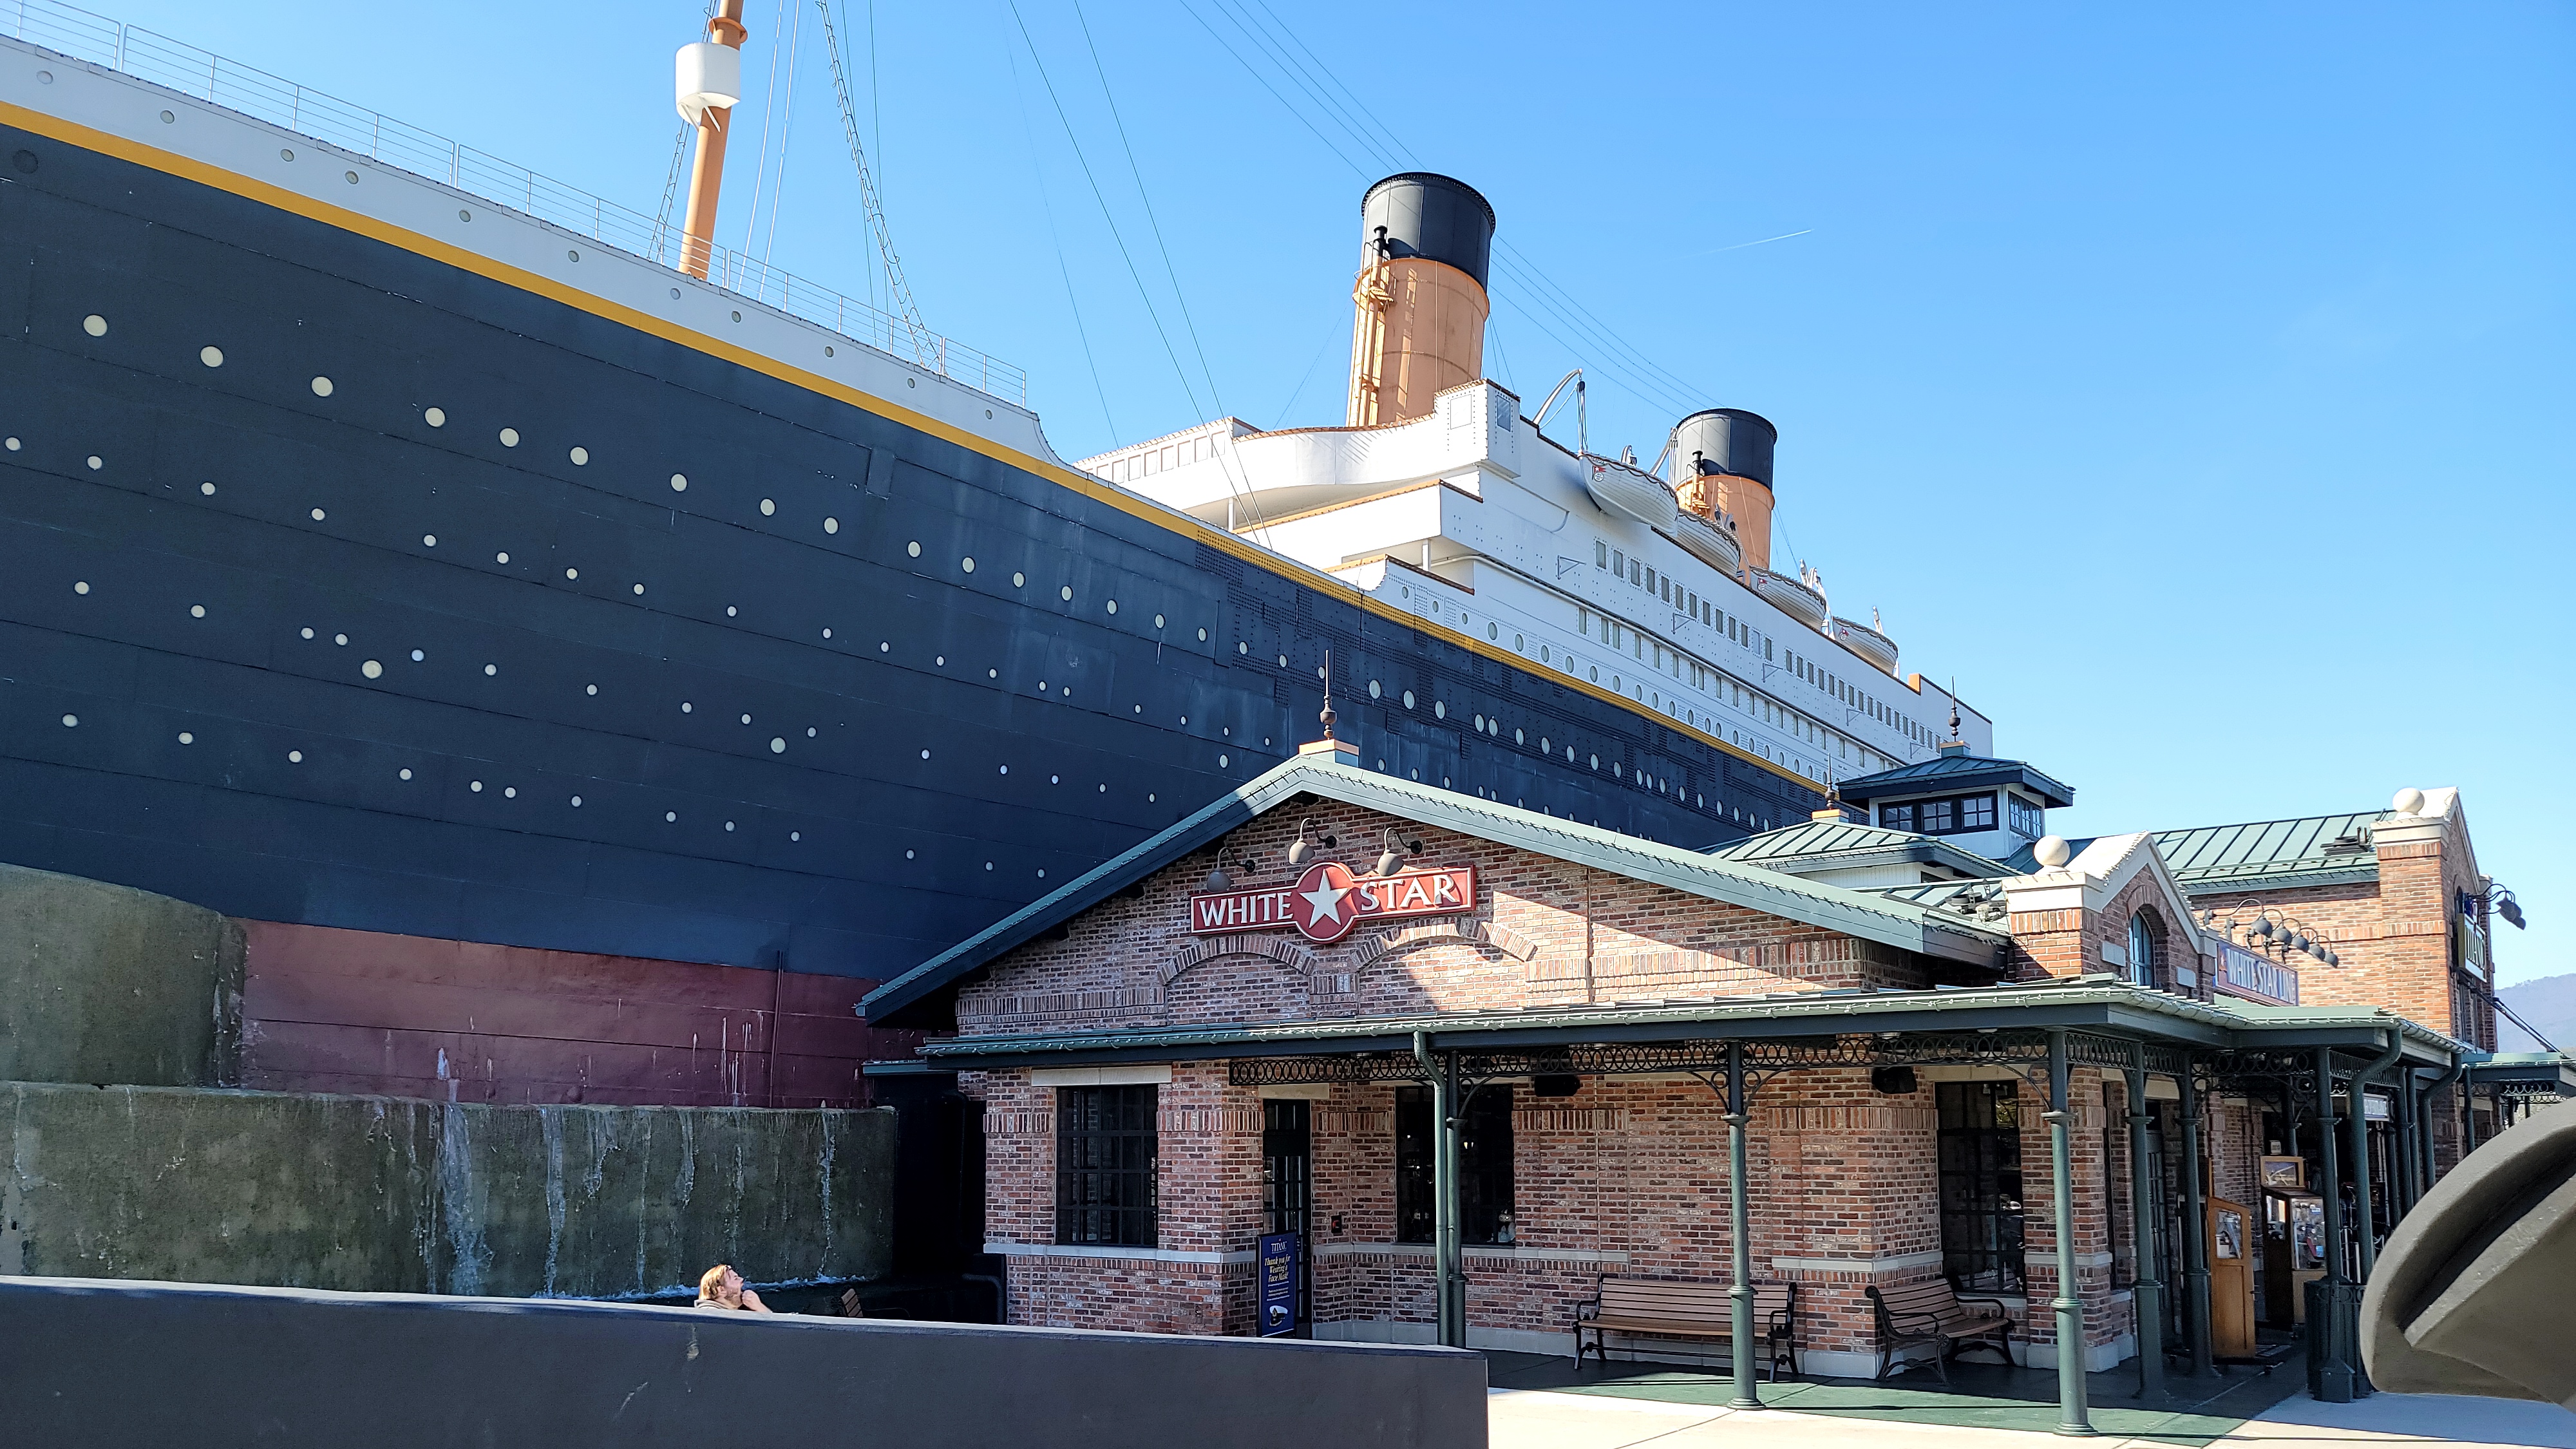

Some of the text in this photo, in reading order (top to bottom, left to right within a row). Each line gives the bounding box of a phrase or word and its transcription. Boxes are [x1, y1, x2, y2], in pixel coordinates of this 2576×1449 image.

[1198, 875, 1461, 927] WHITE STAR
[2226, 948, 2296, 1006] WHITE STAR LINE
